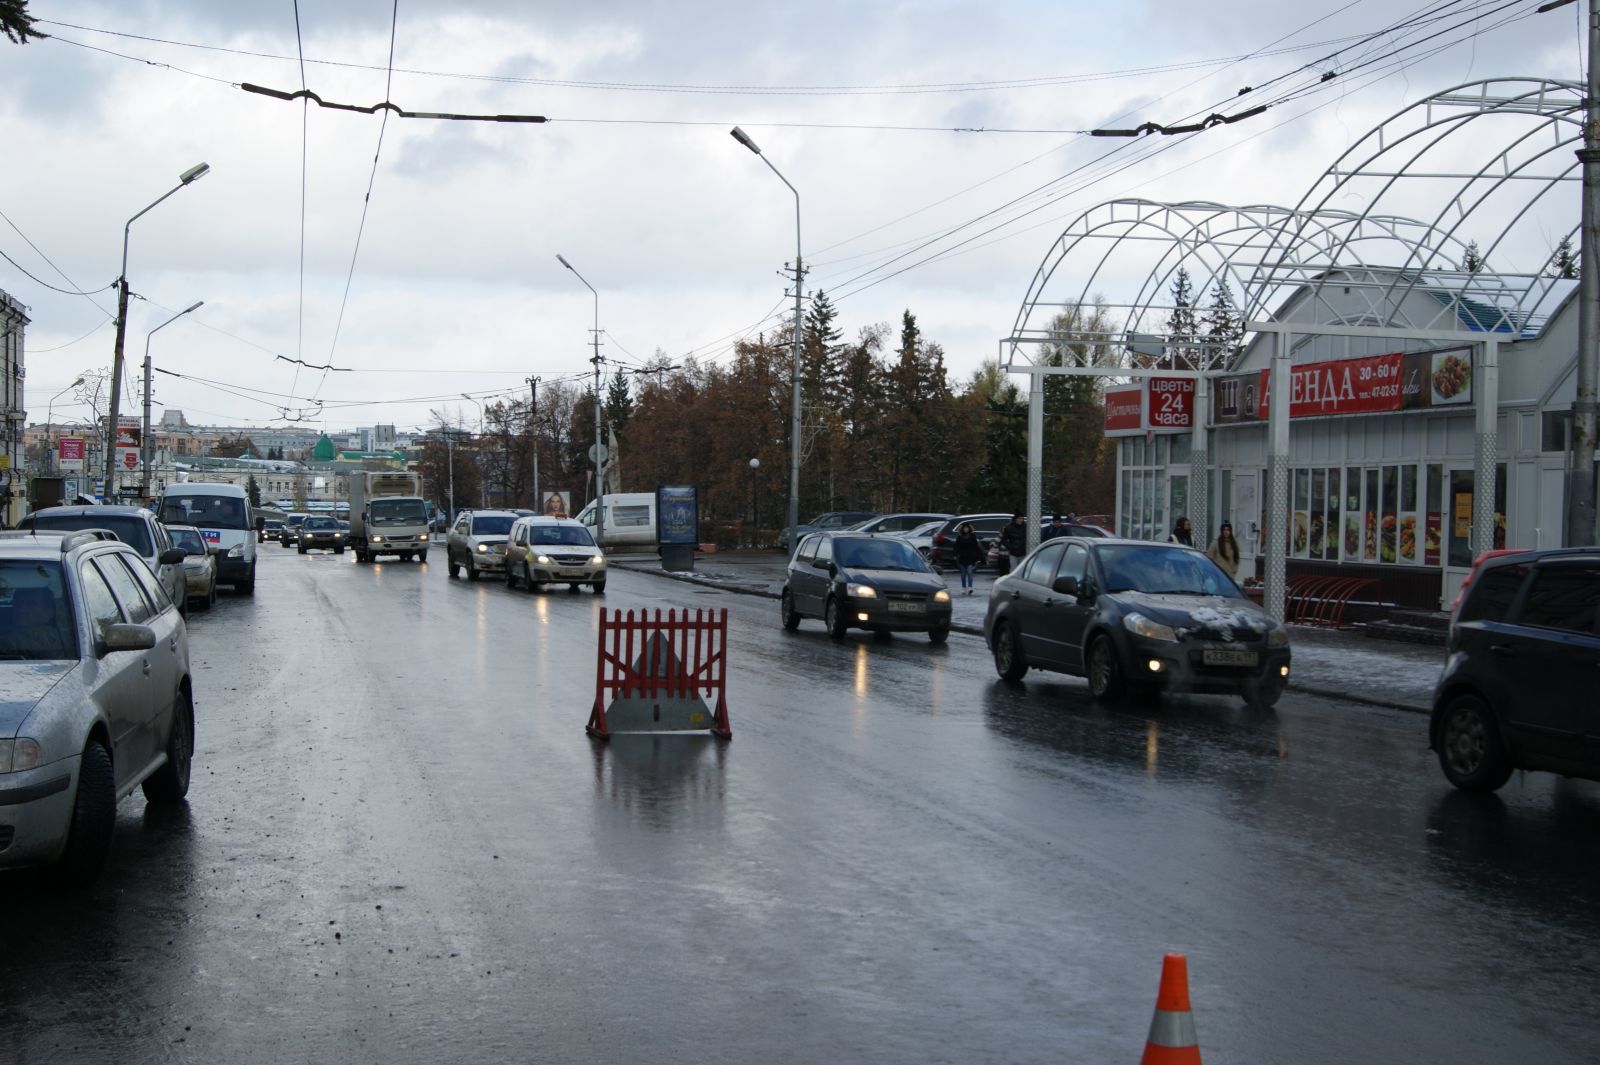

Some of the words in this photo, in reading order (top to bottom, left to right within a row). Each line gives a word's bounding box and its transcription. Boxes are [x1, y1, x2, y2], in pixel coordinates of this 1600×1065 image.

[1359, 367, 1371, 380] 30
[1377, 364, 1389, 378] 60
[1151, 380, 1194, 393] цветы
[1261, 367, 1355, 410] АЕНДА
[1161, 393, 1184, 412] 24
[1154, 412, 1189, 425] часа
